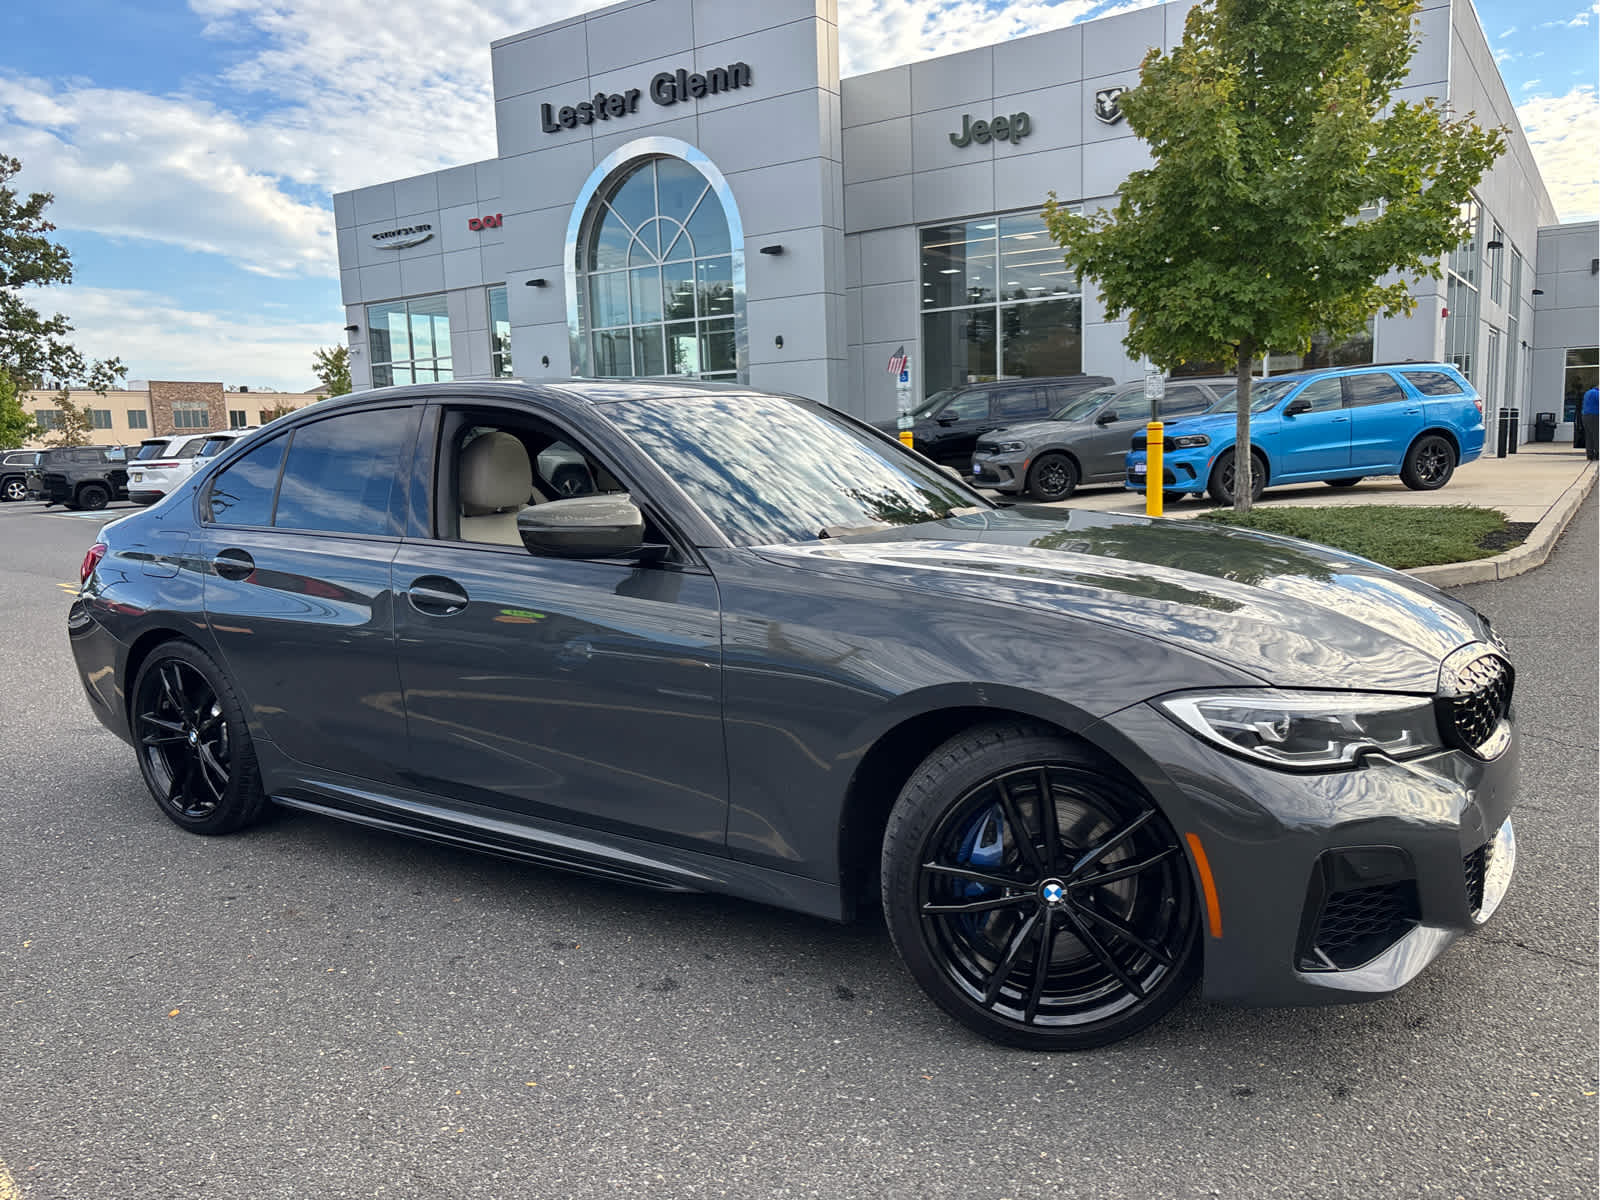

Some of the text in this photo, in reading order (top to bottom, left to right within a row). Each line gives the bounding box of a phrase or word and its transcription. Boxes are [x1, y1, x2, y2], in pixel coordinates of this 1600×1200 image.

[541, 62, 752, 133] Lester Glenn
[949, 112, 1031, 148] Jeep
